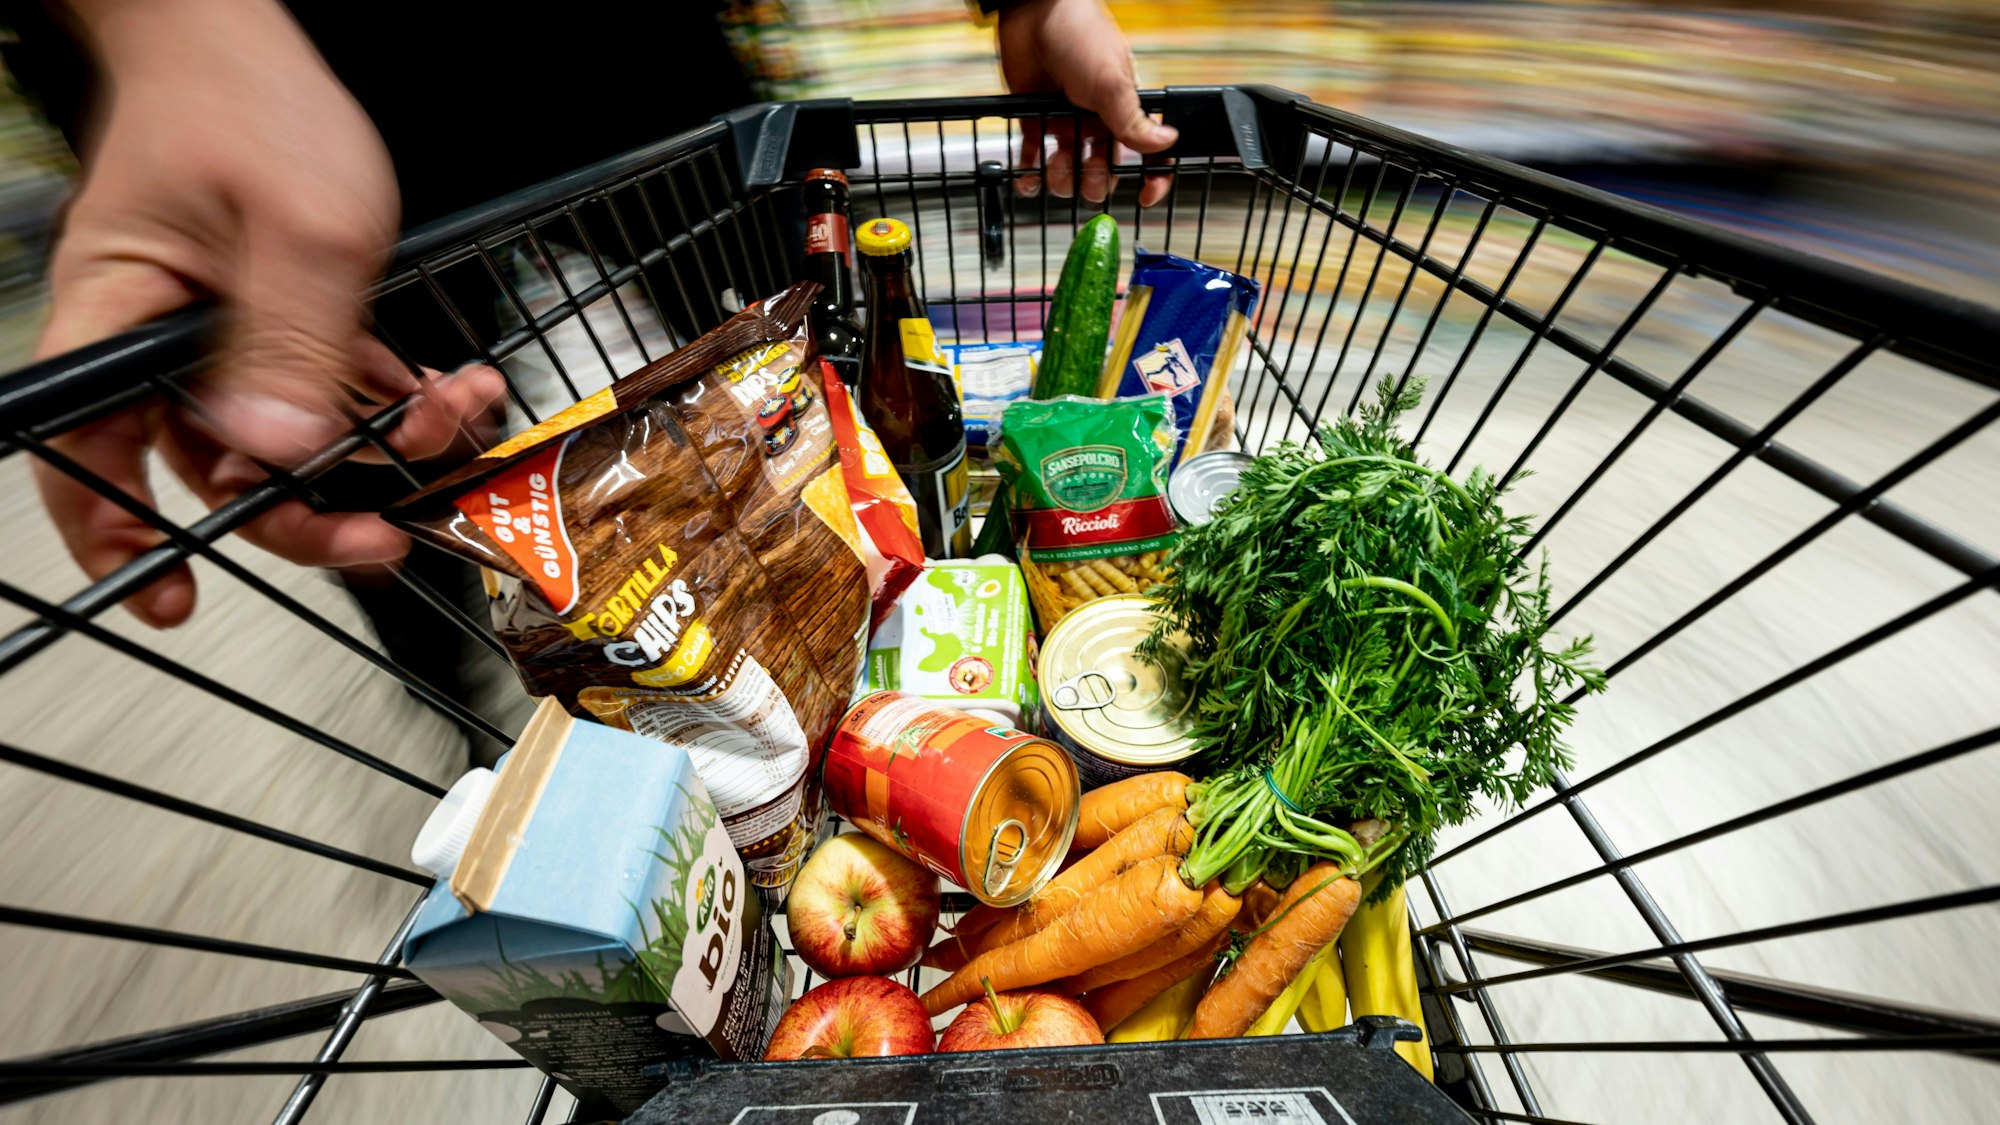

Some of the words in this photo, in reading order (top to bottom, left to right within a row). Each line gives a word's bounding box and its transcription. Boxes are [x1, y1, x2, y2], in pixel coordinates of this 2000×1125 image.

[1048, 453, 1120, 476] SANSEPOLCRO
[1058, 472, 1113, 486] FACTORY
[489, 492, 515, 543] GUT
[512, 517, 532, 534] &
[528, 473, 561, 578] GÜNSTIG
[1061, 514, 1120, 535] Riccioli
[1056, 549, 1102, 559] SELEZIONATA
[1113, 545, 1140, 553] GRANO
[1141, 541, 1160, 549] DURO
[562, 542, 679, 641] TORTILLA
[603, 579, 696, 667] CHIPS
[851, 709, 865, 723] 425
[699, 876, 715, 923] Arla
[699, 869, 736, 987] bio
[738, 950, 747, 973] BIO
[725, 968, 749, 1041] VOLLMILCH
